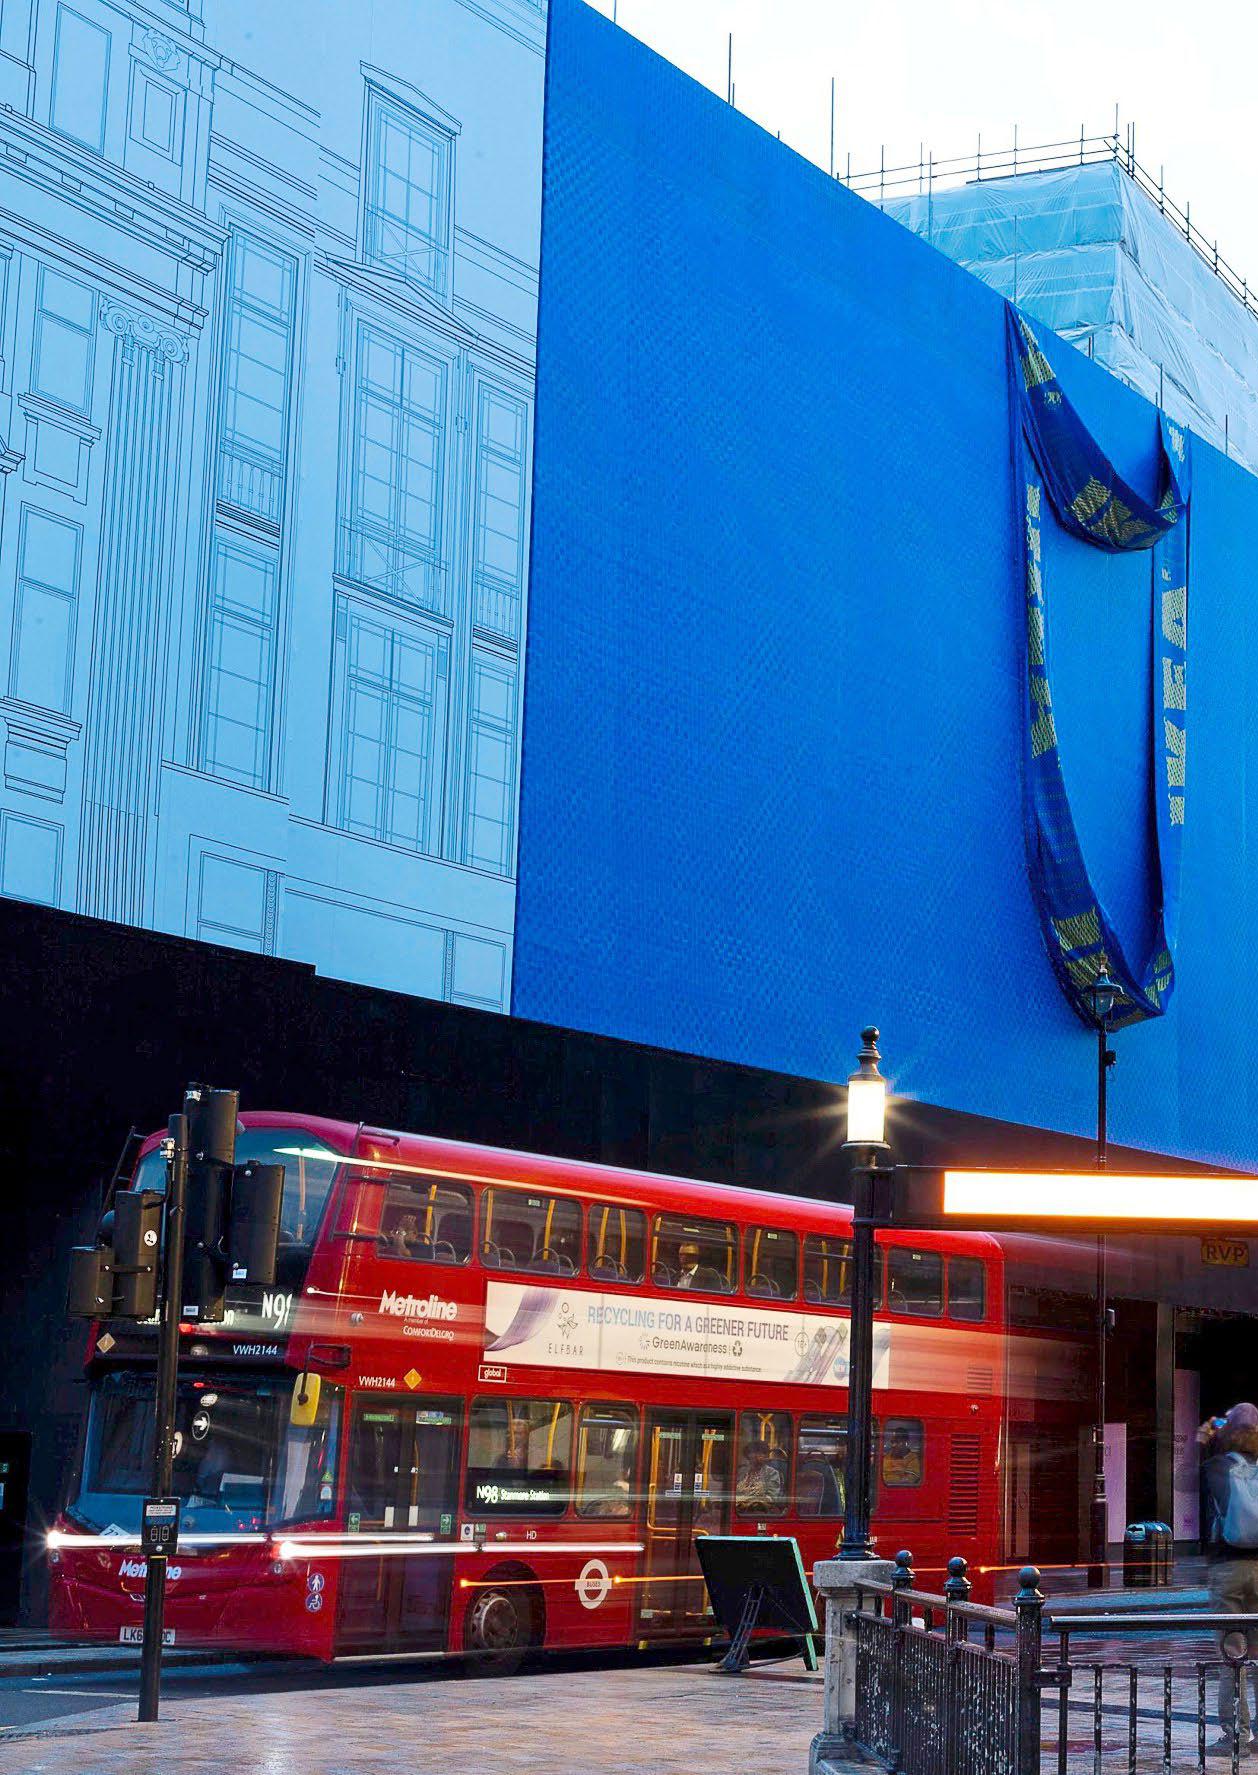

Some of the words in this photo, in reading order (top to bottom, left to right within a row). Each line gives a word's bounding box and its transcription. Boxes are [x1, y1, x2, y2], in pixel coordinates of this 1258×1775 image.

[1206, 1245, 1245, 1262] RVP
[378, 1289, 458, 1321] Metroline
[587, 1305, 655, 1329] RECYCLING
[658, 1312, 682, 1332] FOR
[684, 1315, 693, 1333] A
[695, 1316, 745, 1337] GREENER
[747, 1321, 789, 1341] FUTURE
[233, 1344, 278, 1355] VWH2144
[548, 1342, 584, 1356] ELFBAR
[652, 1336, 727, 1354] GreenAwareness
[627, 1355, 637, 1363] This
[484, 1368, 501, 1379] global
[358, 1375, 396, 1388] VWH2144
[476, 1485, 499, 1504] N98
[500, 1488, 529, 1500] Stanmore
[529, 1489, 550, 1500] Station
[526, 1530, 537, 1540] HD
[119, 1559, 182, 1580] Metrne
[586, 1580, 601, 1588] BUSES
